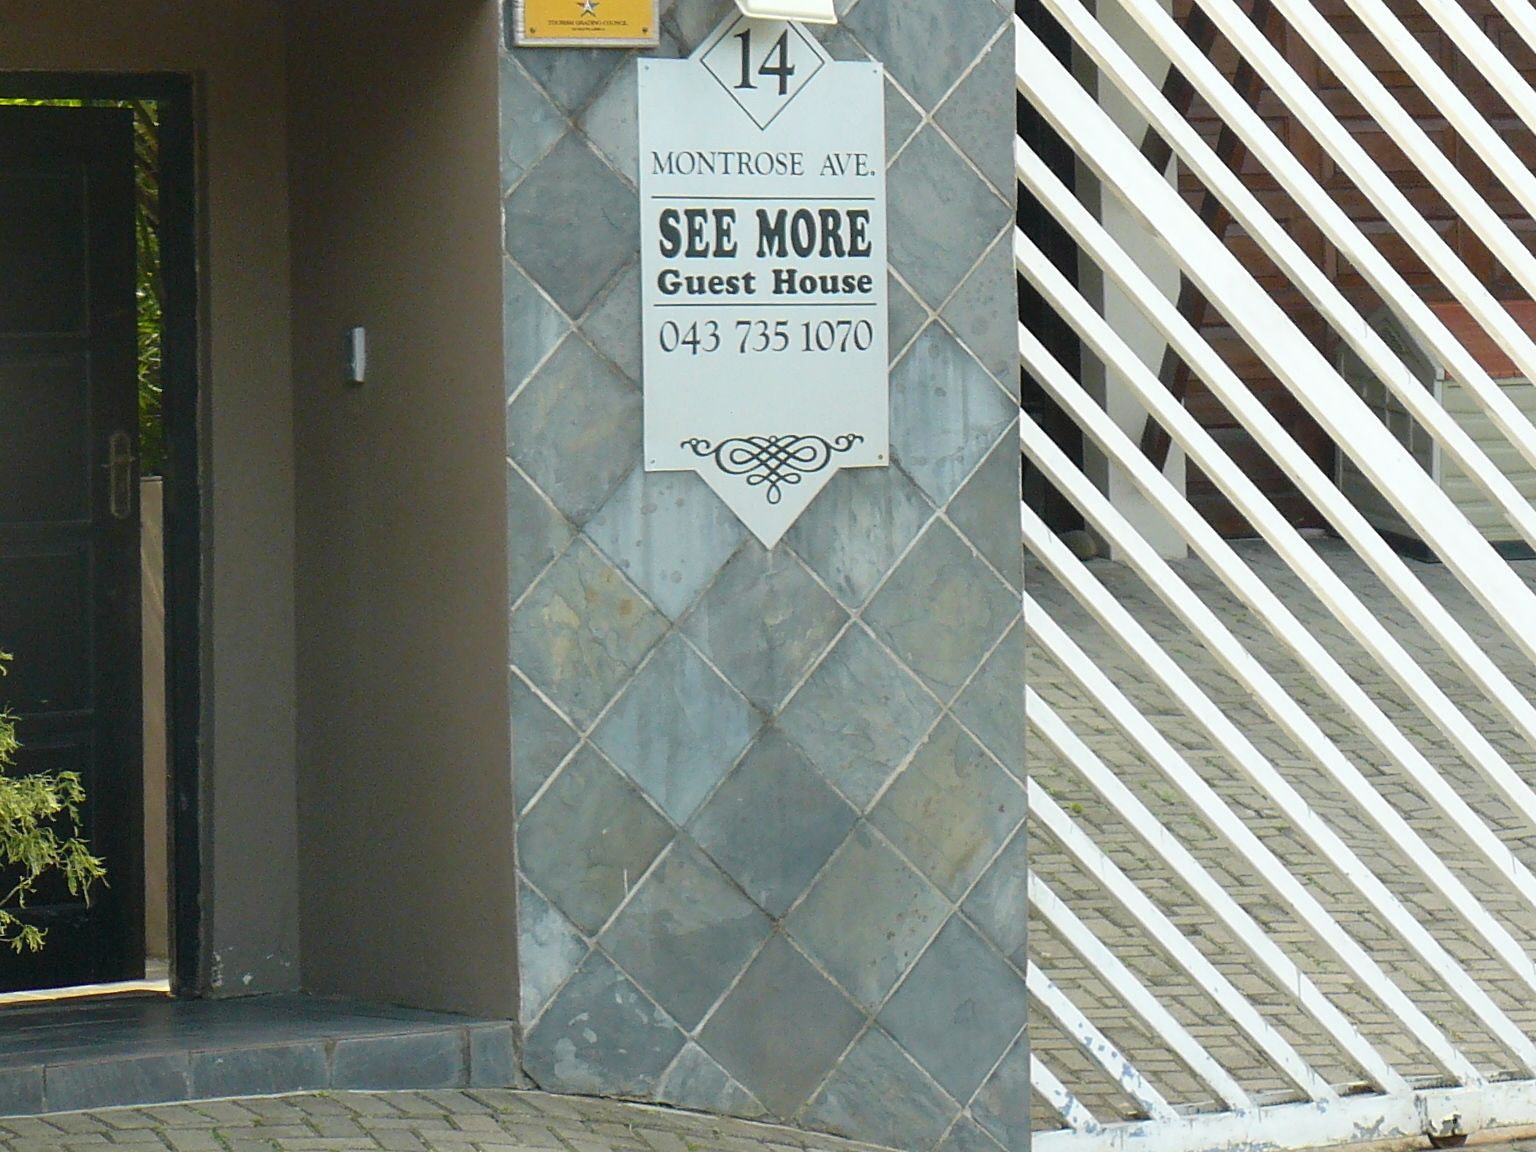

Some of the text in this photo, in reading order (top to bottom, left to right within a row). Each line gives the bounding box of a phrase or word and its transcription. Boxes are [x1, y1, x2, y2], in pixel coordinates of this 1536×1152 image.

[733, 28, 795, 96] 14
[652, 151, 876, 177] MONTROSE AVE.
[659, 208, 872, 258] SEE MORE
[657, 269, 873, 295] Guest House
[659, 319, 873, 355] 043 735 1070
